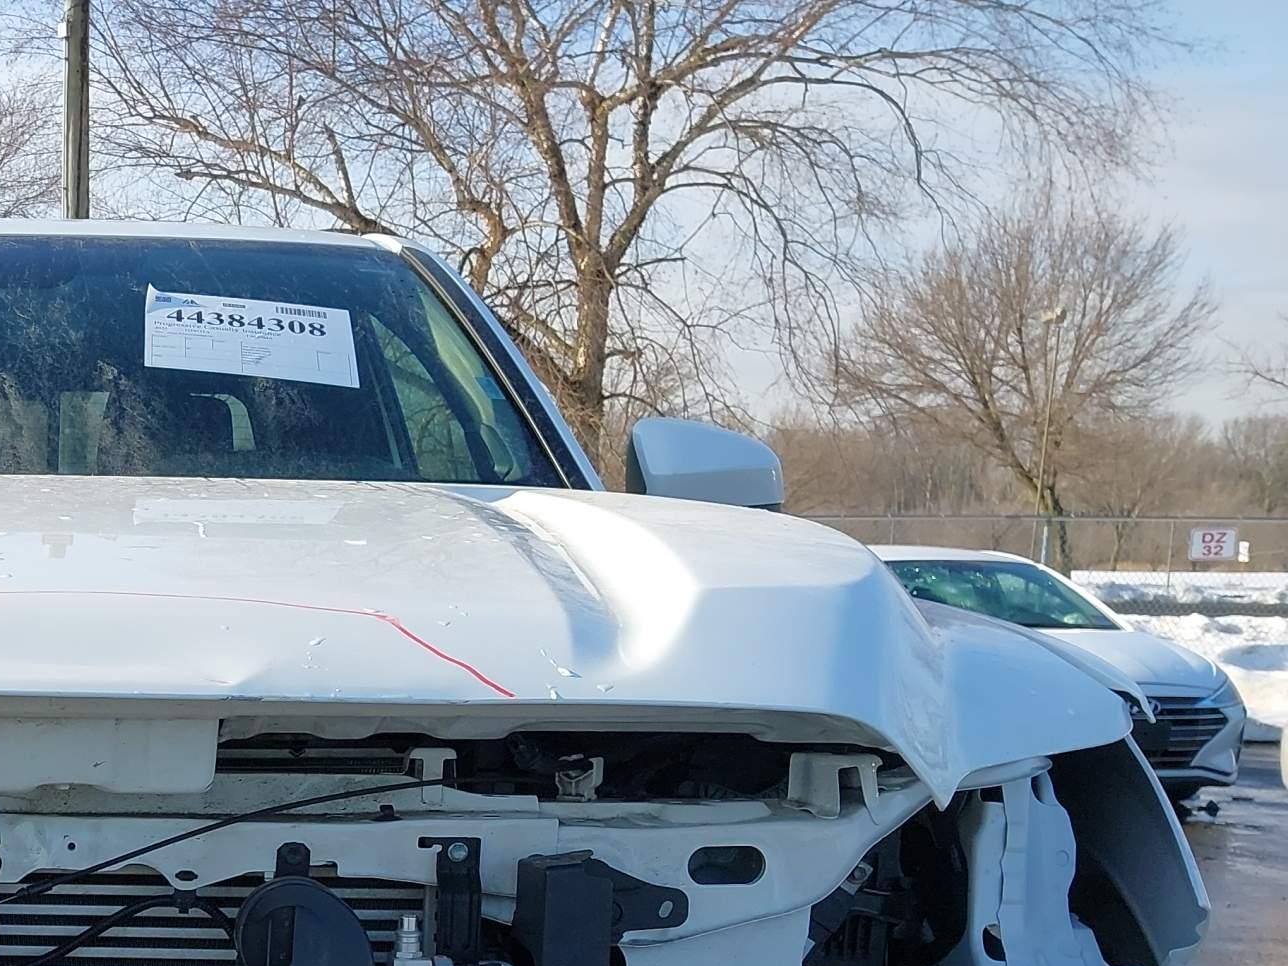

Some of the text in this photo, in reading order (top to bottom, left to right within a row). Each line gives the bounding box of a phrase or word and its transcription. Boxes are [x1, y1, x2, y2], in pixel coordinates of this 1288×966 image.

[166, 309, 326, 337] 44384308
[1201, 532, 1227, 544] DZ
[1201, 545, 1224, 556] 32
